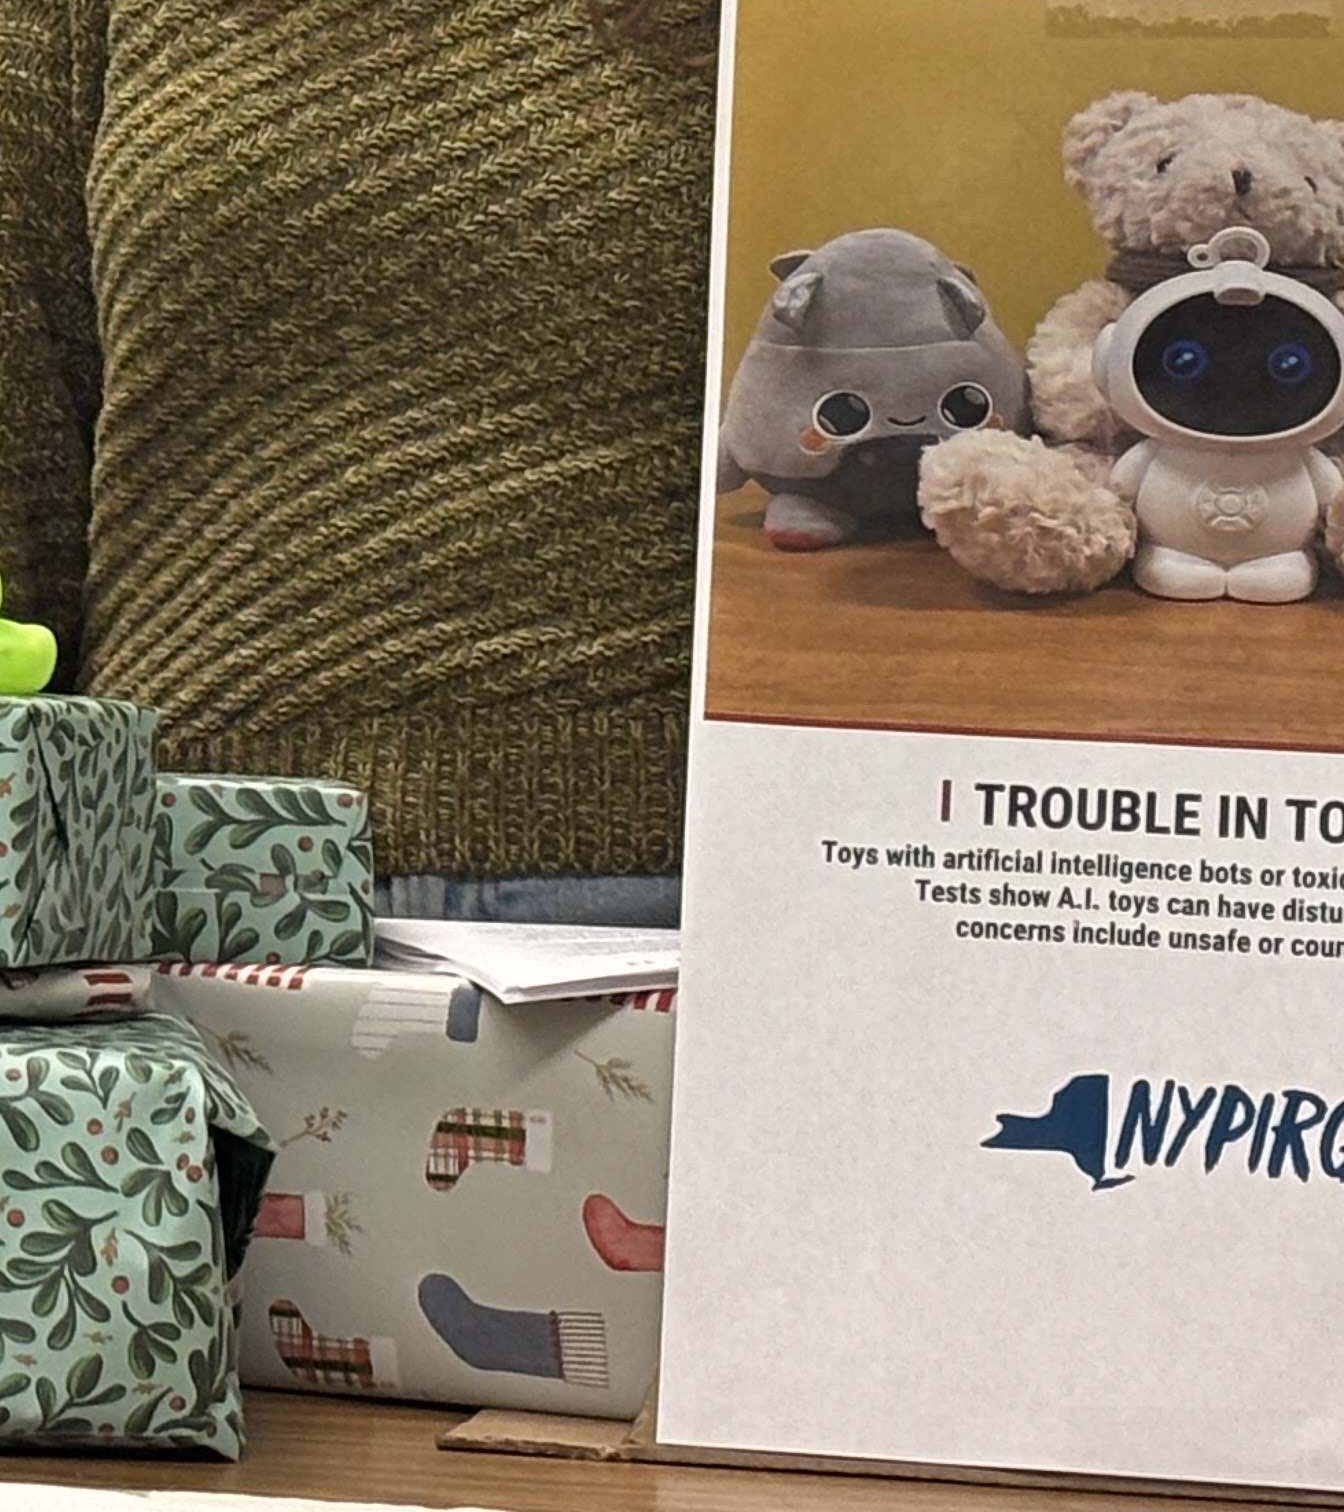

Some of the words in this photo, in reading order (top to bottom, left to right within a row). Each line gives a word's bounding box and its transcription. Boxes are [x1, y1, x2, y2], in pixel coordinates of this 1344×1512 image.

[975, 783, 1202, 838] TROUBLE
[1218, 794, 1268, 840] IN
[821, 839, 879, 868] Toys
[886, 845, 935, 870] with
[942, 848, 1043, 875] artificial
[1051, 851, 1192, 883] intelligence
[1199, 859, 1253, 884] bots
[1260, 866, 1285, 887] or
[915, 879, 982, 905] Tests
[989, 882, 1051, 908] show
[1057, 888, 1100, 911] A.I.
[1109, 889, 1159, 917] toys
[1166, 895, 1209, 917] can
[1217, 893, 1274, 920] have
